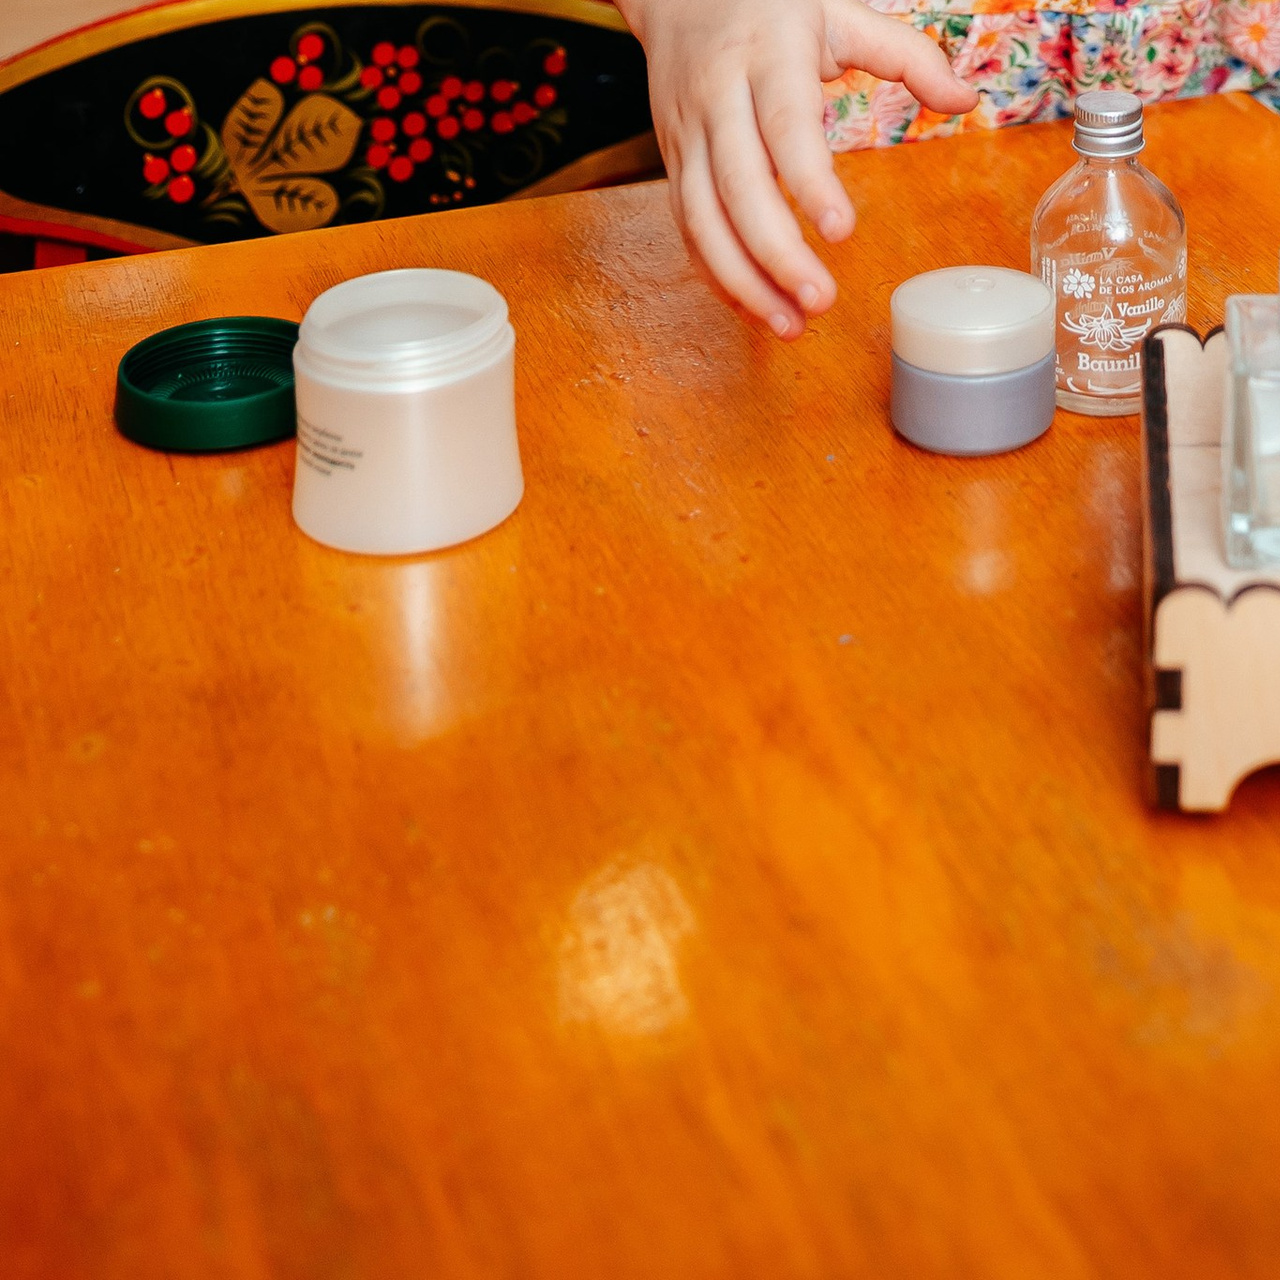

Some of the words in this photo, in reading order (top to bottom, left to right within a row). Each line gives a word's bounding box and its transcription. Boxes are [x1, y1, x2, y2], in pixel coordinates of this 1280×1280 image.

[1099, 276, 1113, 285] LA
[1116, 274, 1144, 285] CASA
[1099, 286, 1113, 295] DE
[1115, 285, 1135, 295] LOS
[1138, 274, 1173, 292] AROMAS
[1116, 296, 1165, 317] Vanille
